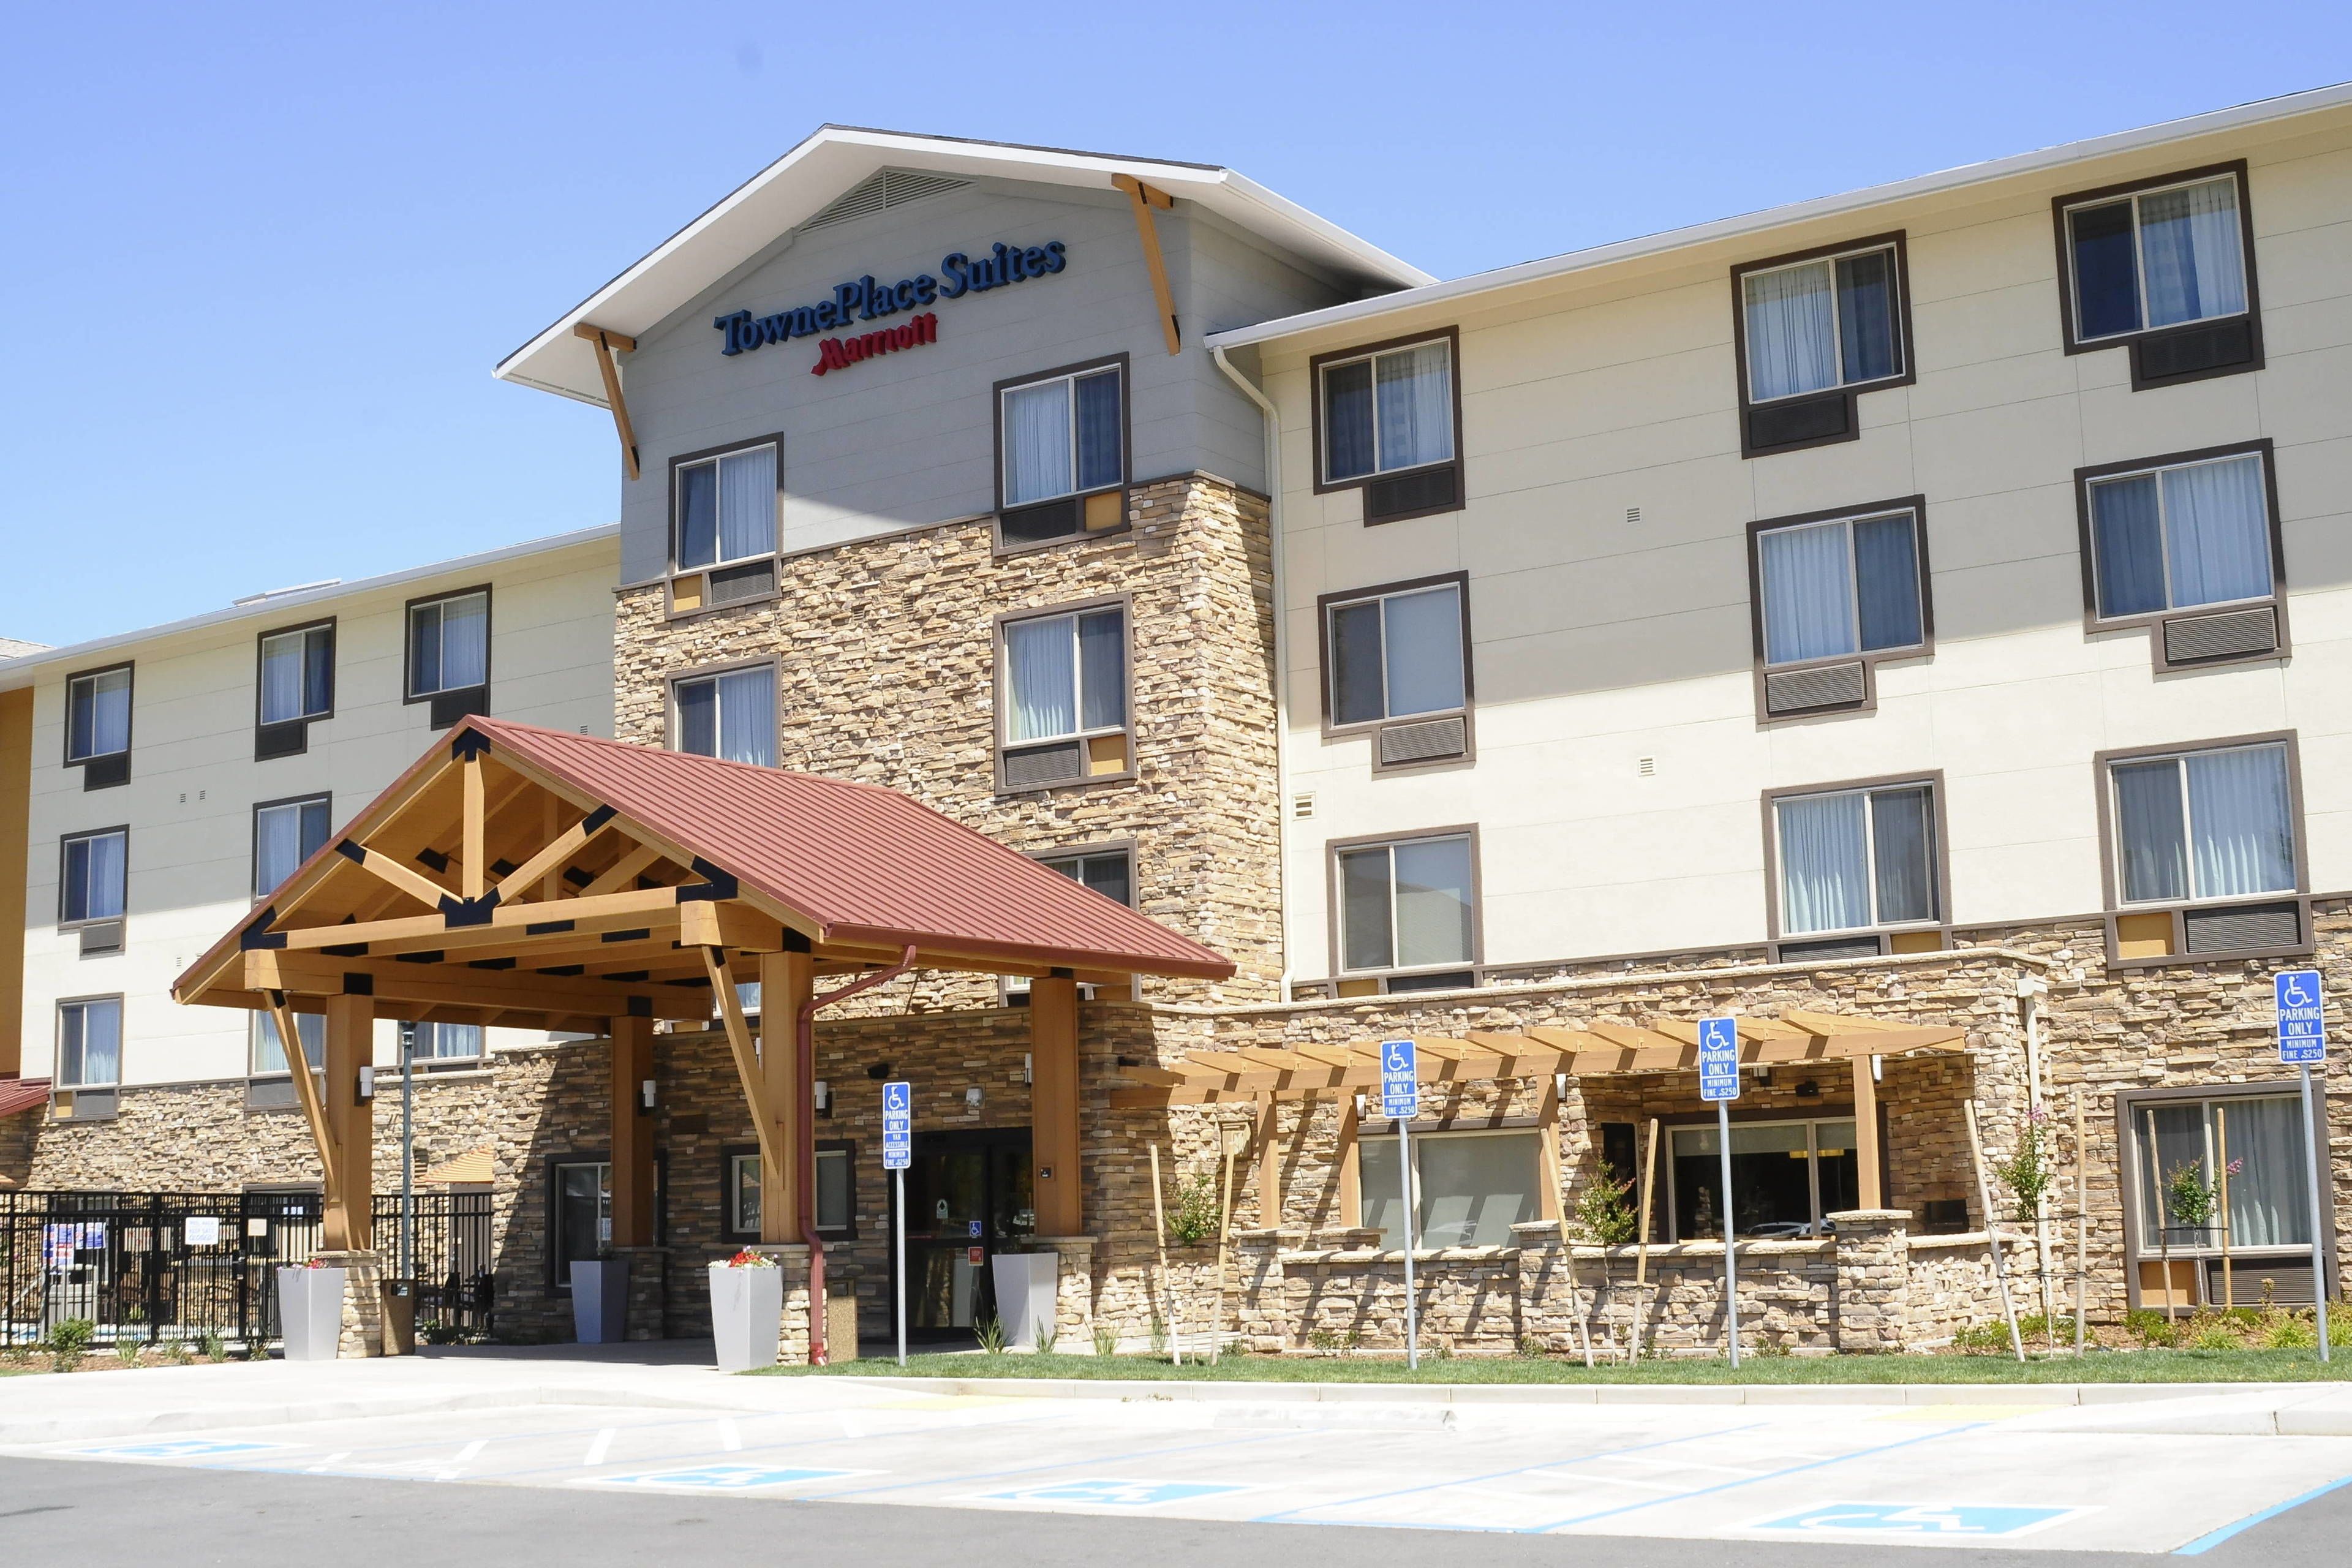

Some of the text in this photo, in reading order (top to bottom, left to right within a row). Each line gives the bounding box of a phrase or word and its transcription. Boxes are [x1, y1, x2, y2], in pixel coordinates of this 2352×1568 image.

[714, 241, 1066, 356] TownePlace Suites
[811, 312, 938, 376] Marriott
[2280, 1007, 2320, 1022] PARKING
[2288, 1022, 2313, 1035] ONLY
[2286, 1039, 2316, 1049] MINIMUM
[1702, 1050, 1735, 1063] PARKING
[2282, 1050, 2298, 1060] FINE
[1708, 1063, 1729, 1076] ONLY
[1384, 1071, 1414, 1083] PARKING
[1707, 1078, 1732, 1087] MINIMUM
[1390, 1083, 1408, 1095] ONLY
[1703, 1088, 1717, 1097] FINE
[885, 1110, 908, 1120] PARKING
[889, 1120, 903, 1131] ONLY
